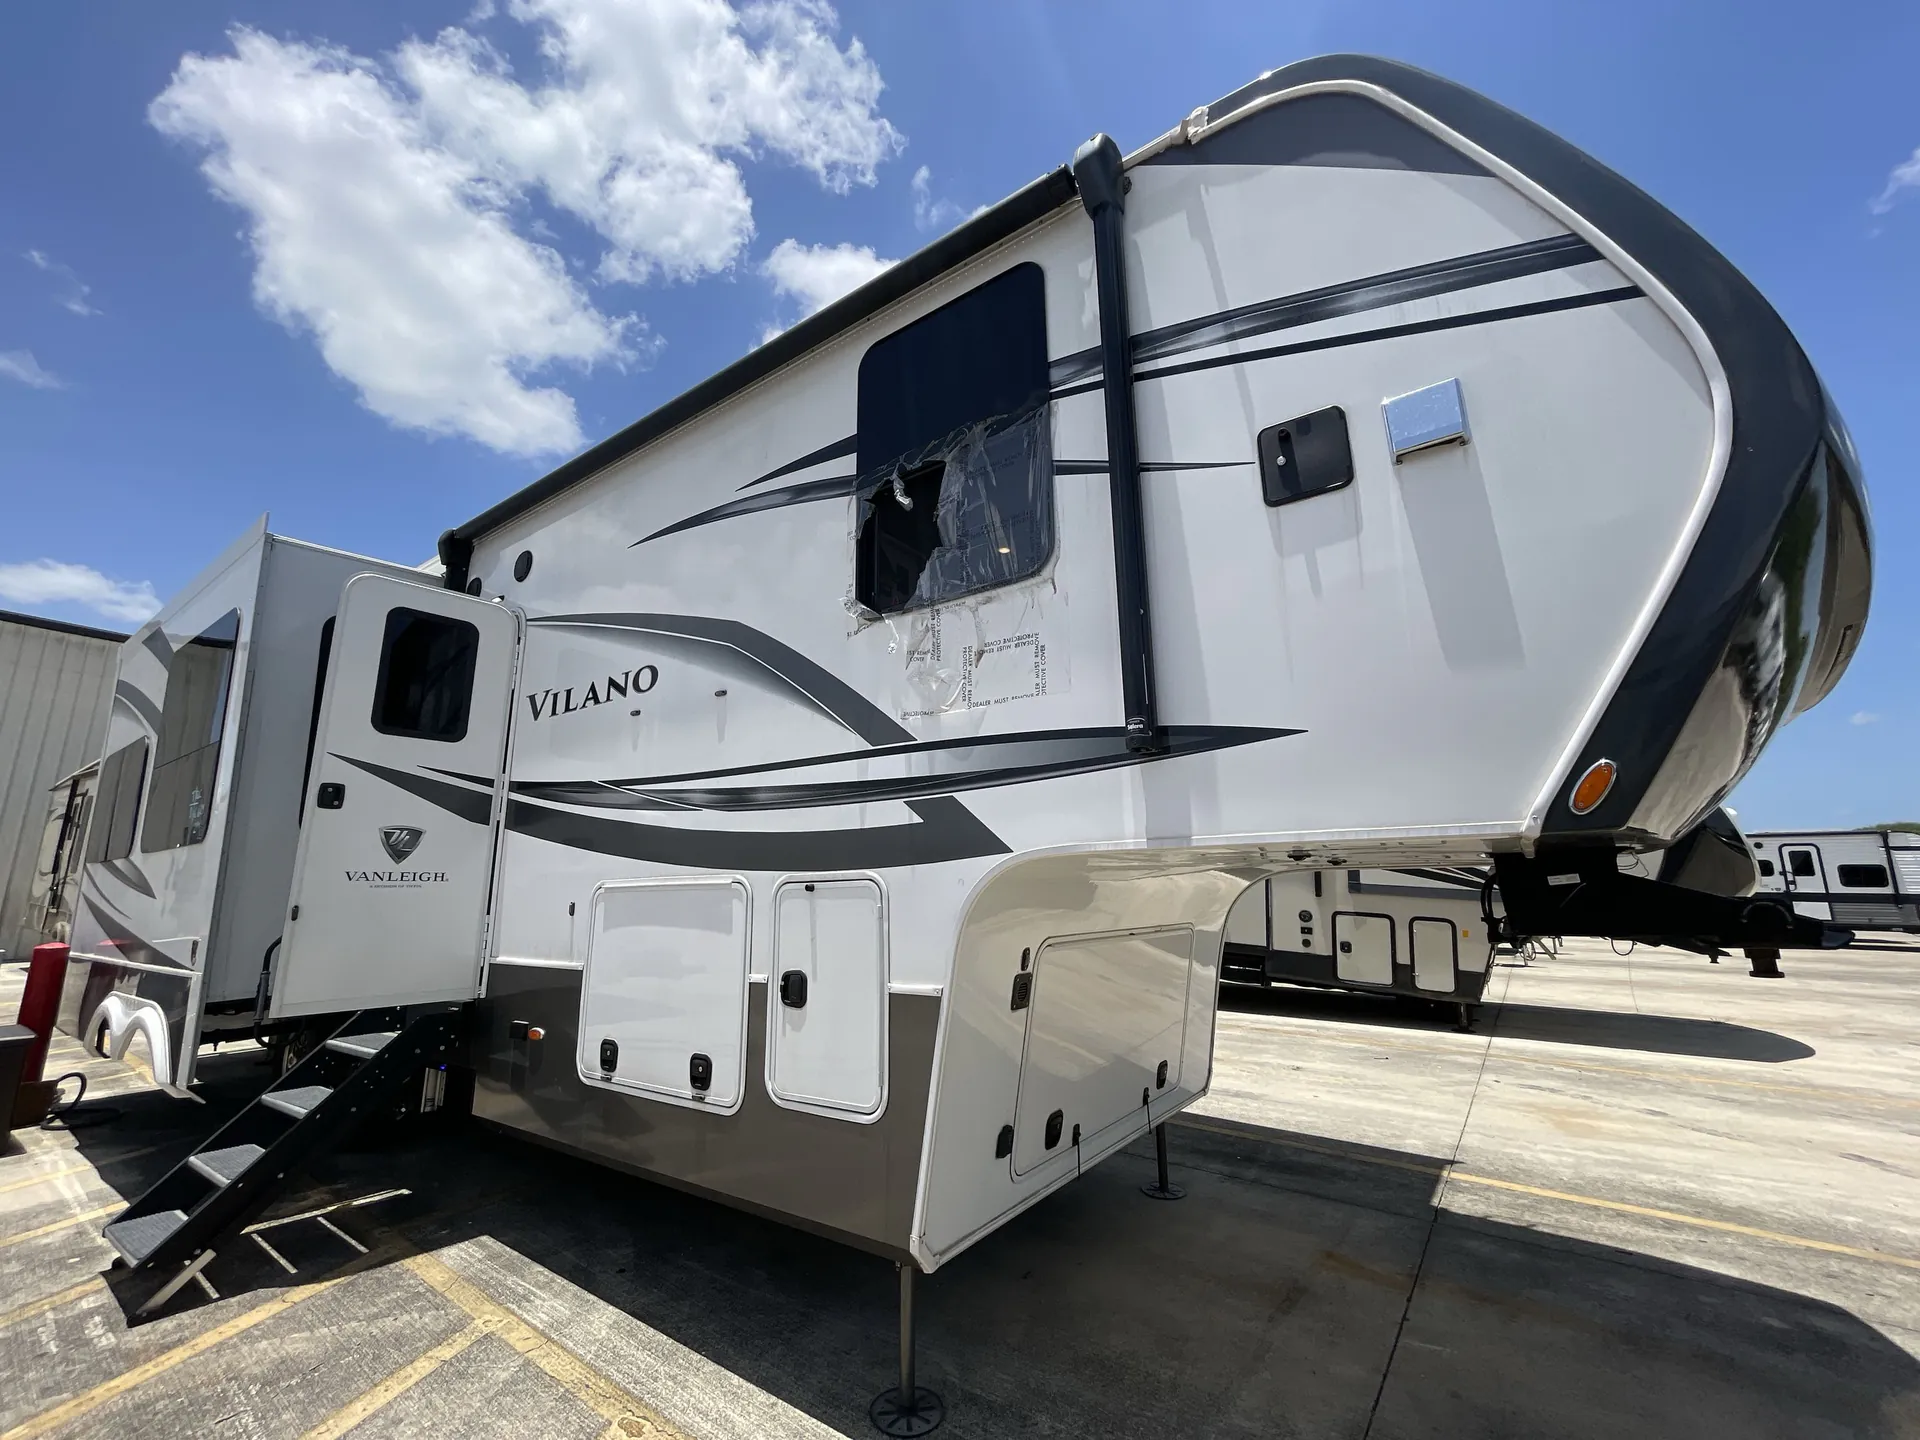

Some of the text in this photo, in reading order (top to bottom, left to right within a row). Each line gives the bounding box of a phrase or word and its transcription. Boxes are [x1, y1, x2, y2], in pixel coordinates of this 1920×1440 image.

[984, 640, 1002, 648] COVER
[996, 644, 1012, 652] MUST
[1014, 640, 1034, 649] DEALER
[526, 664, 659, 722] VILANO
[972, 699, 991, 708] DEALER
[344, 871, 447, 882] VANLEIGH
